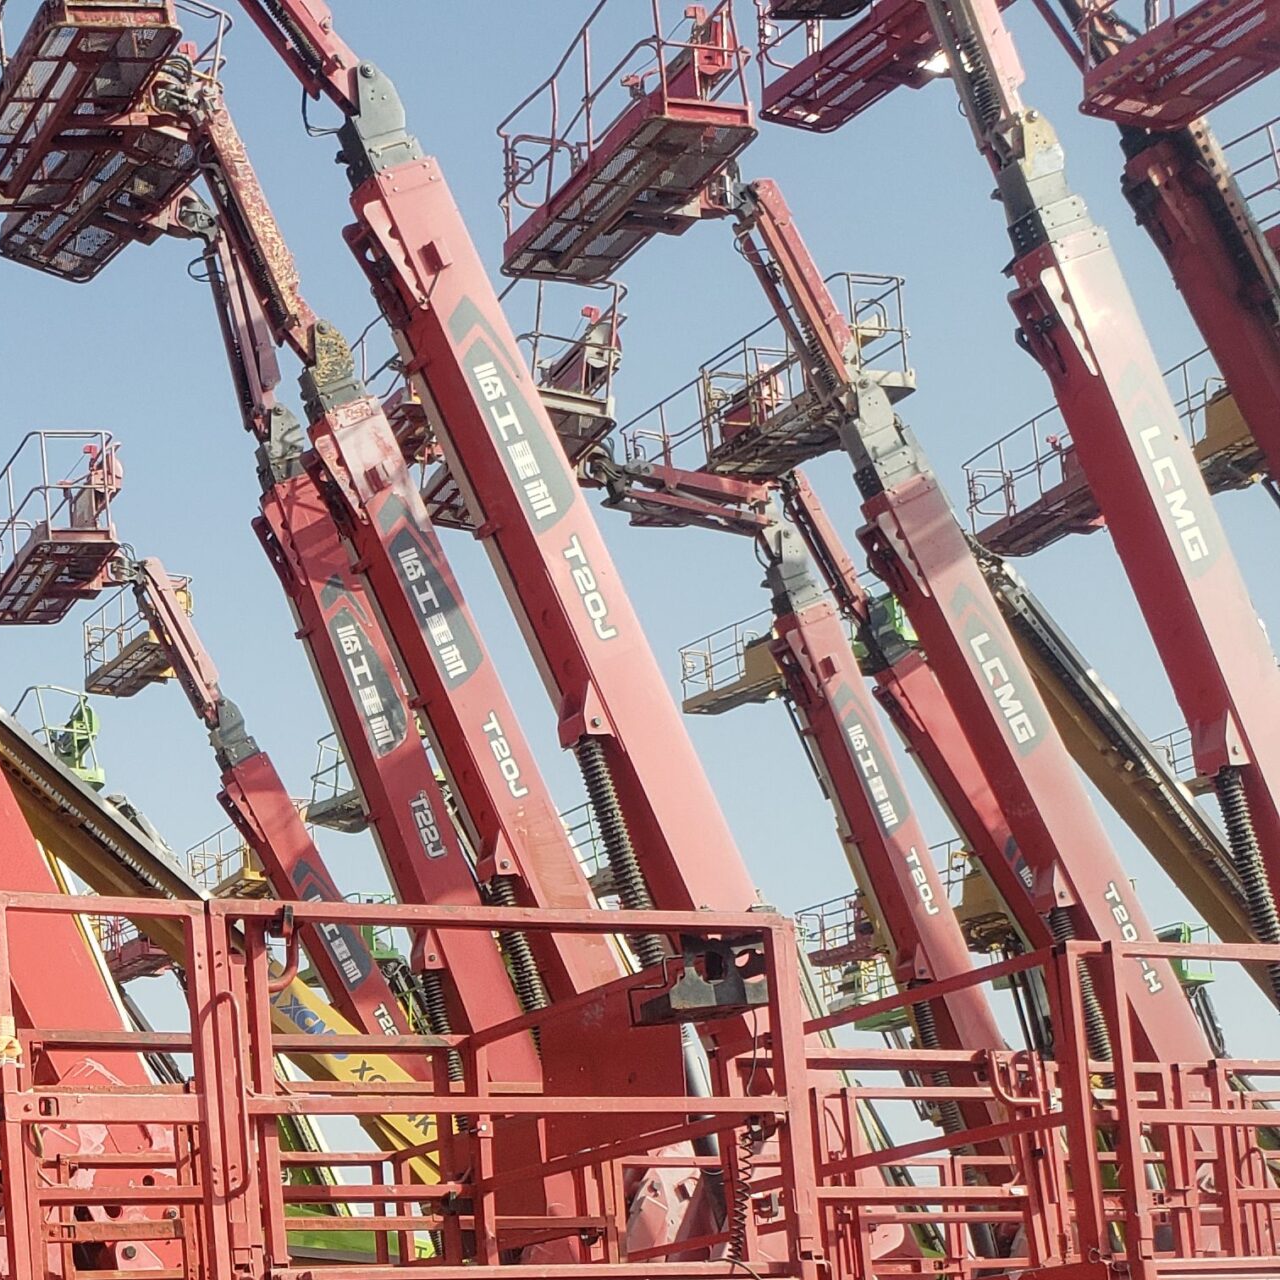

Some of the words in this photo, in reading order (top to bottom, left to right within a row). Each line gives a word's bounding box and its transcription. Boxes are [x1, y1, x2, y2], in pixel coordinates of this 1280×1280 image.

[562, 536, 616, 640] T20J
[481, 714, 528, 796] T20J
[906, 847, 939, 915] T20J
